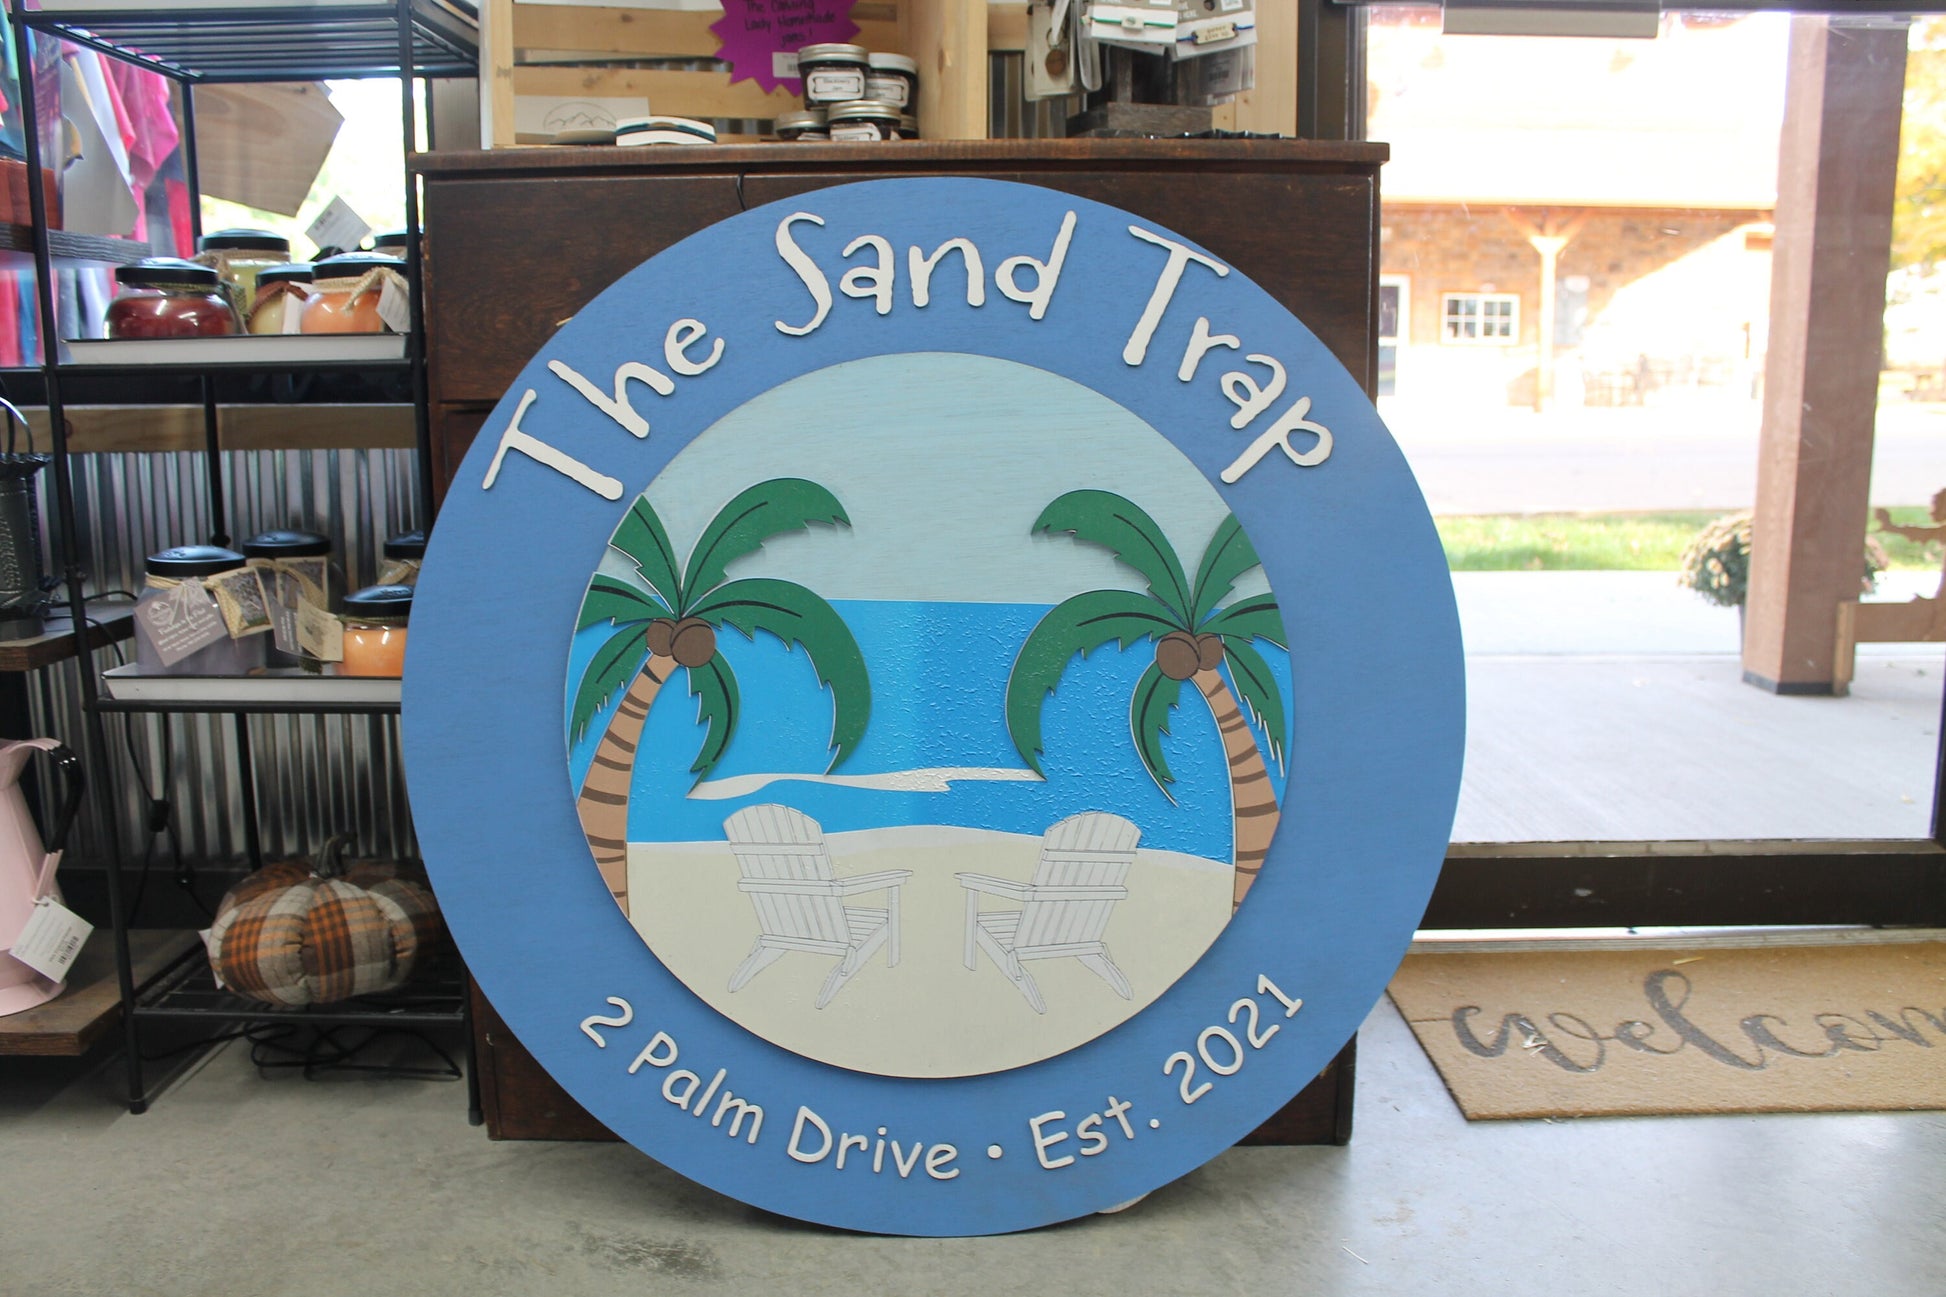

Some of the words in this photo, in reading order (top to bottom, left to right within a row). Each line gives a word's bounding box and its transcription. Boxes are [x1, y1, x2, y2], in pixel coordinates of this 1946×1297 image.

[481, 318, 726, 501] The
[774, 210, 1078, 336] Sand
[1122, 224, 1334, 484] Trap
[579, 995, 634, 1049] 2
[627, 1030, 765, 1145] Palm
[786, 1105, 961, 1181] Drive
[1028, 1095, 1161, 1170] Est.
[1162, 973, 1304, 1105] 2021
